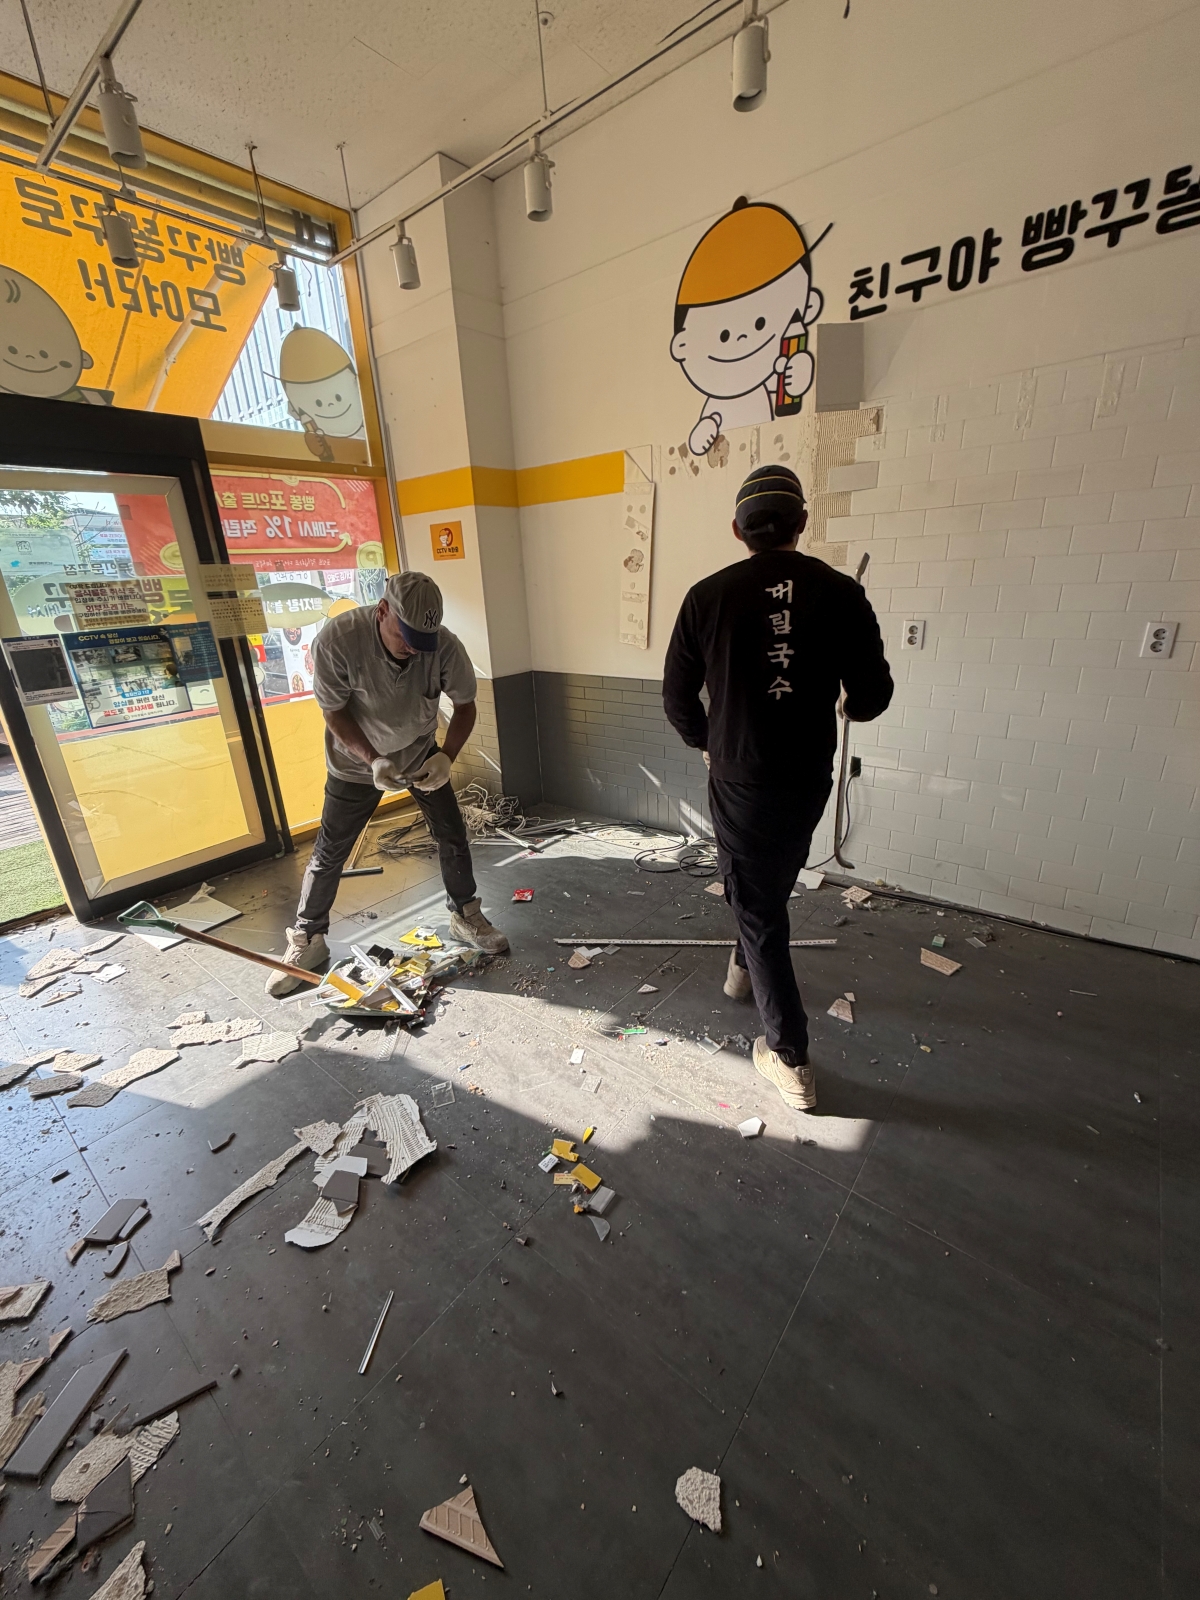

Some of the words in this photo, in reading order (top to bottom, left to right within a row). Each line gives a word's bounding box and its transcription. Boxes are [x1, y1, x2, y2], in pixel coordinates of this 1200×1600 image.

[848, 228, 1002, 321] 친구야
[424, 608, 439, 629] NY
[78, 634, 99, 642] CCTV
[113, 699, 134, 708] 양심을
[136, 696, 151, 704] 버린
[152, 694, 166, 702] 당신
